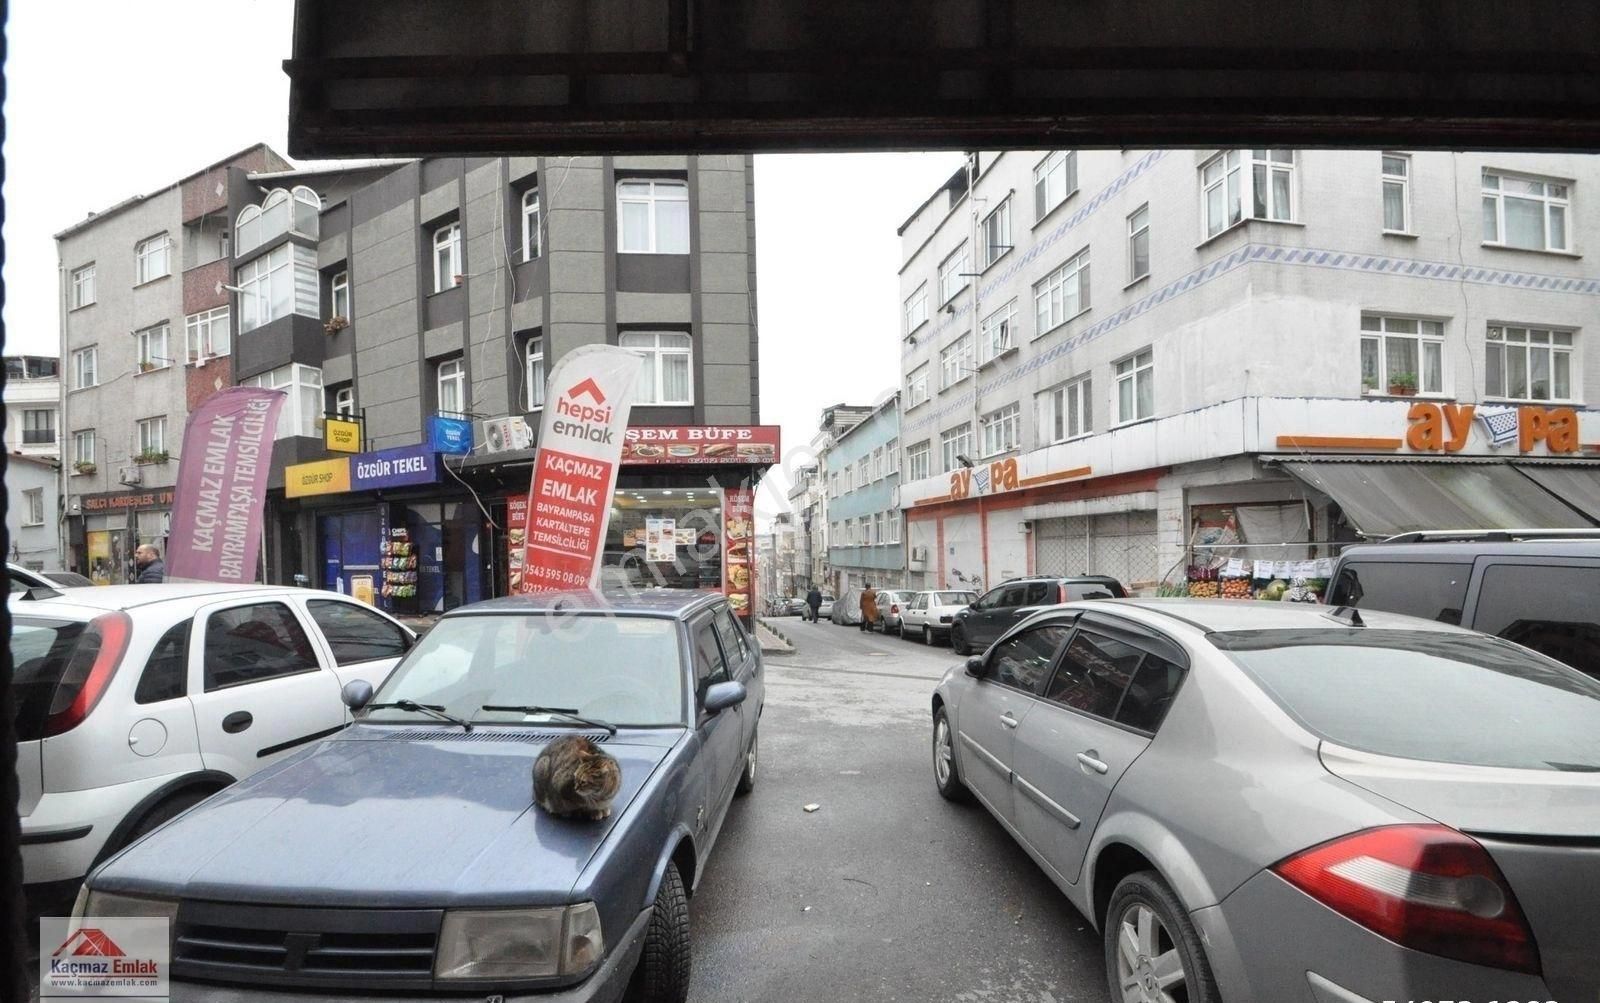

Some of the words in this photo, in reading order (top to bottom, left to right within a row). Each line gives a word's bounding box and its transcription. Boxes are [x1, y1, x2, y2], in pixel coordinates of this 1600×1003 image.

[556, 396, 612, 424] hepsi
[552, 420, 614, 445] emlak
[687, 427, 753, 440] BÜFE
[204, 414, 236, 475] EMLAK
[319, 472, 333, 483] SHOP
[357, 459, 391, 479] ÖZGÜR
[392, 456, 428, 474] TEKEL
[545, 454, 604, 480] KAÇMAZ
[541, 479, 598, 506] EMLAK
[191, 480, 224, 553] KAÇMAZ
[537, 502, 595, 523] BAYRAMPAŞA
[536, 517, 590, 537] KARTALTEPE
[533, 531, 590, 551] TEMSİLCİLİĞİ
[524, 564, 545, 577] 0543
[545, 568, 562, 581] 595
[562, 572, 574, 584] 08
[574, 574, 585, 586] 09
